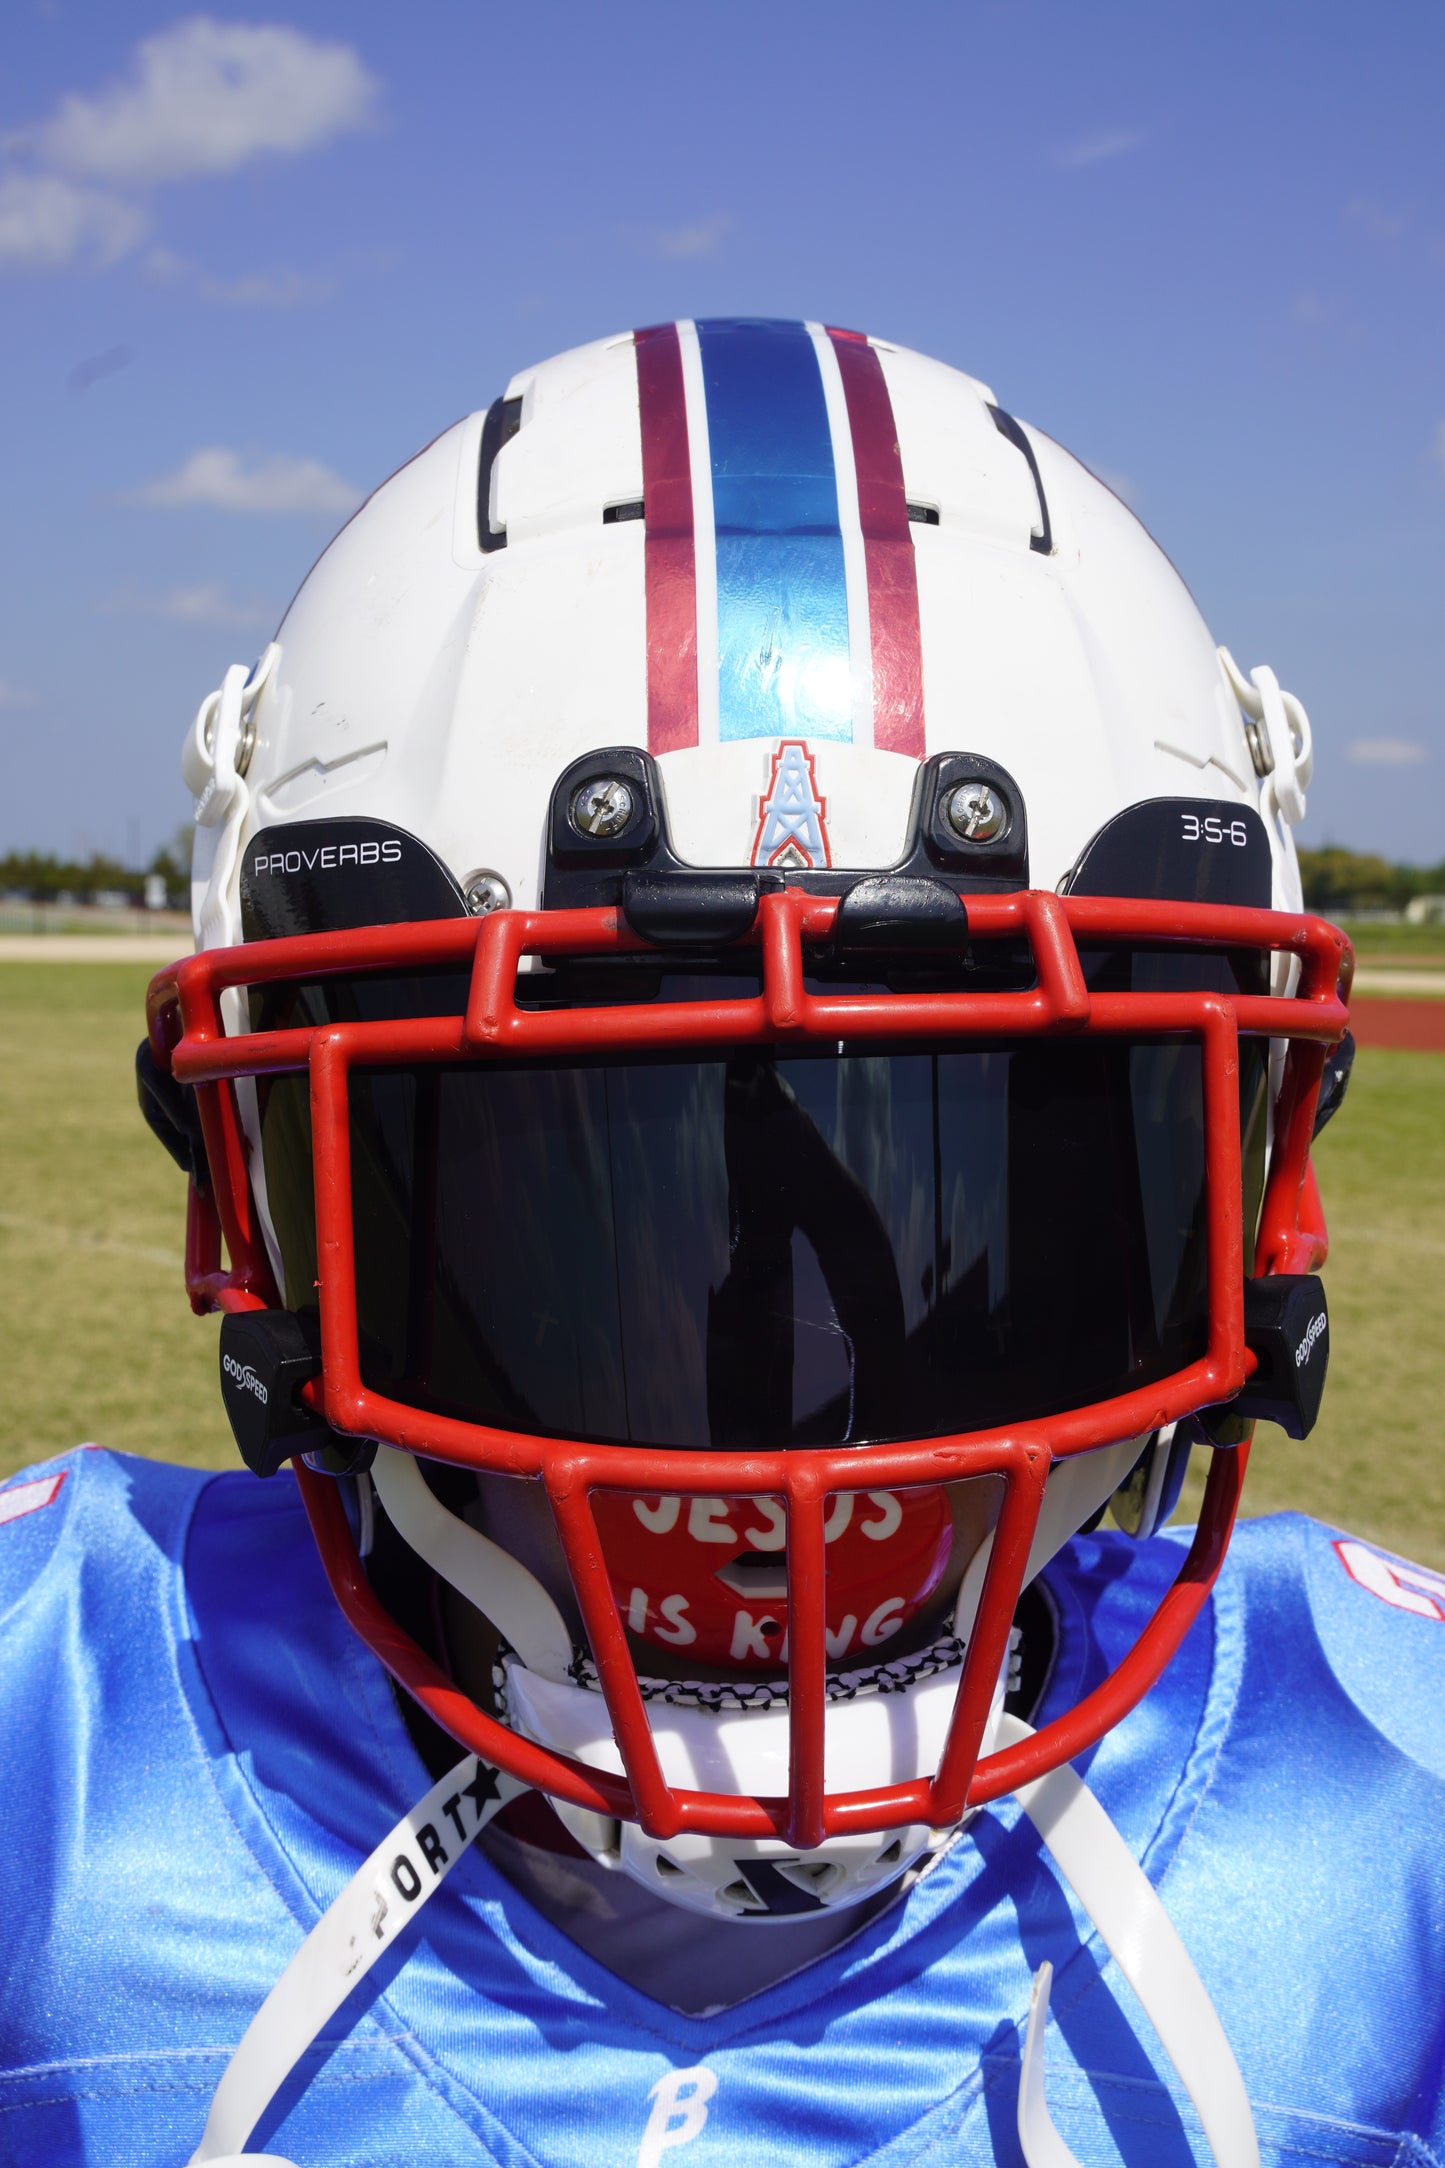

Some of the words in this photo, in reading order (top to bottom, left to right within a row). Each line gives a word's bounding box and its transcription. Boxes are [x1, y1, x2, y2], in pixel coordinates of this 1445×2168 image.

[1181, 814, 1247, 846] 3:5-6
[254, 841, 402, 877] PROVERBS
[628, 1587, 697, 1646] IS
[346, 1793, 468, 1976] PORT
